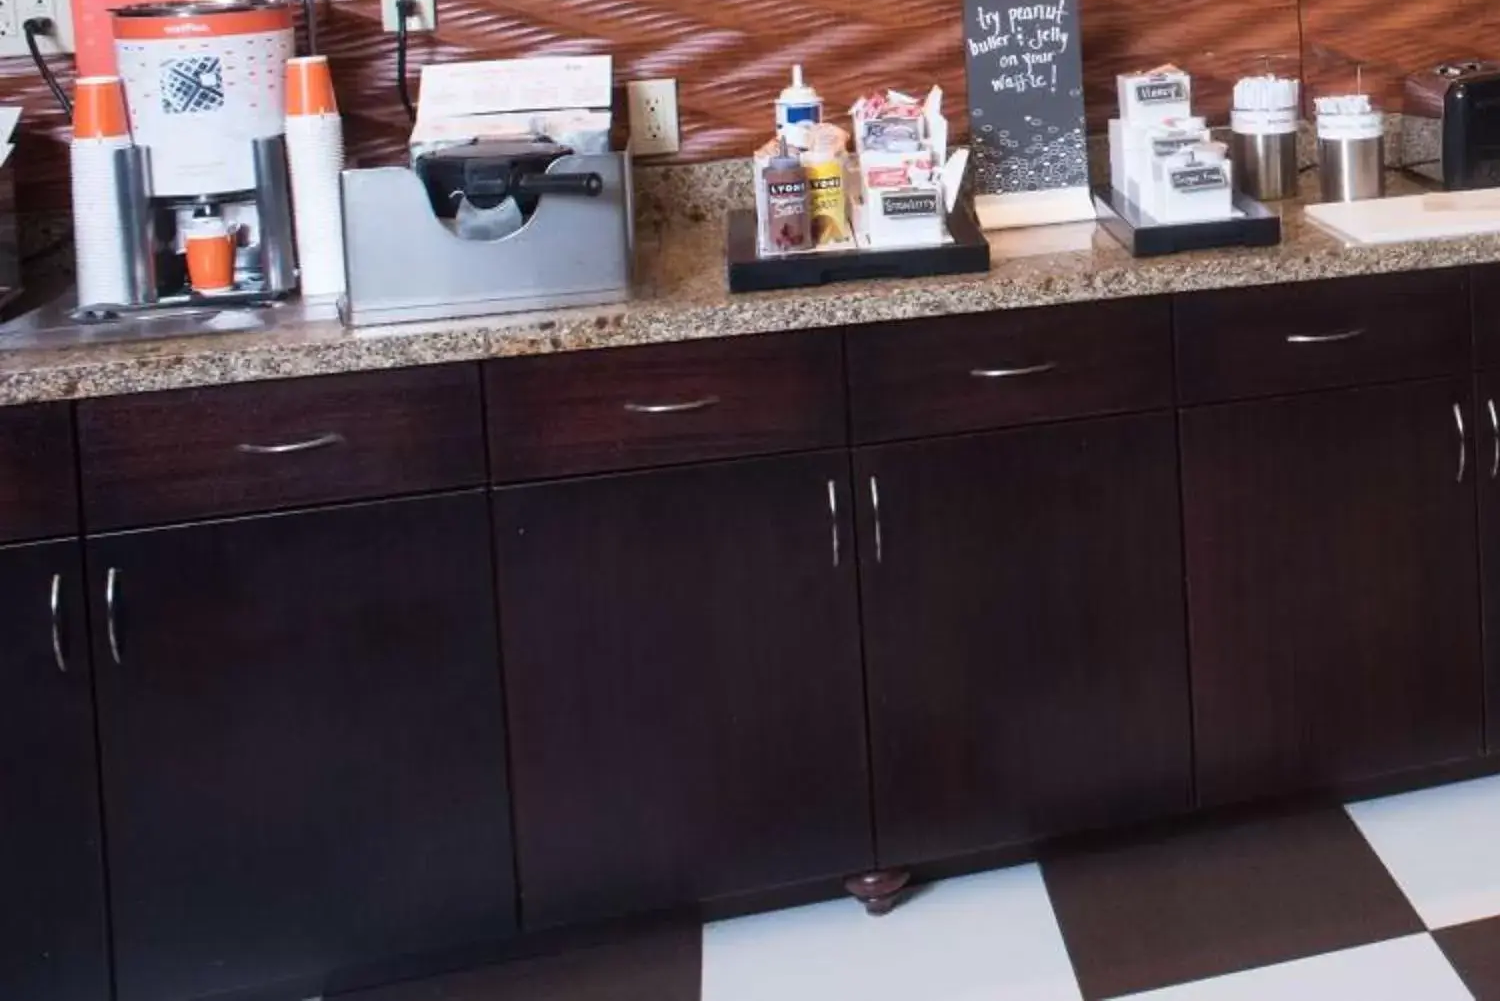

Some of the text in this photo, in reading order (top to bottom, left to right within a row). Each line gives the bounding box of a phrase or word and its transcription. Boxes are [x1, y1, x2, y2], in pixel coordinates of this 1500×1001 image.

[976, 6, 1000, 36] try
[967, 34, 1010, 57] butter
[1028, 24, 1069, 53] jelly
[1000, 52, 1056, 75] on your
